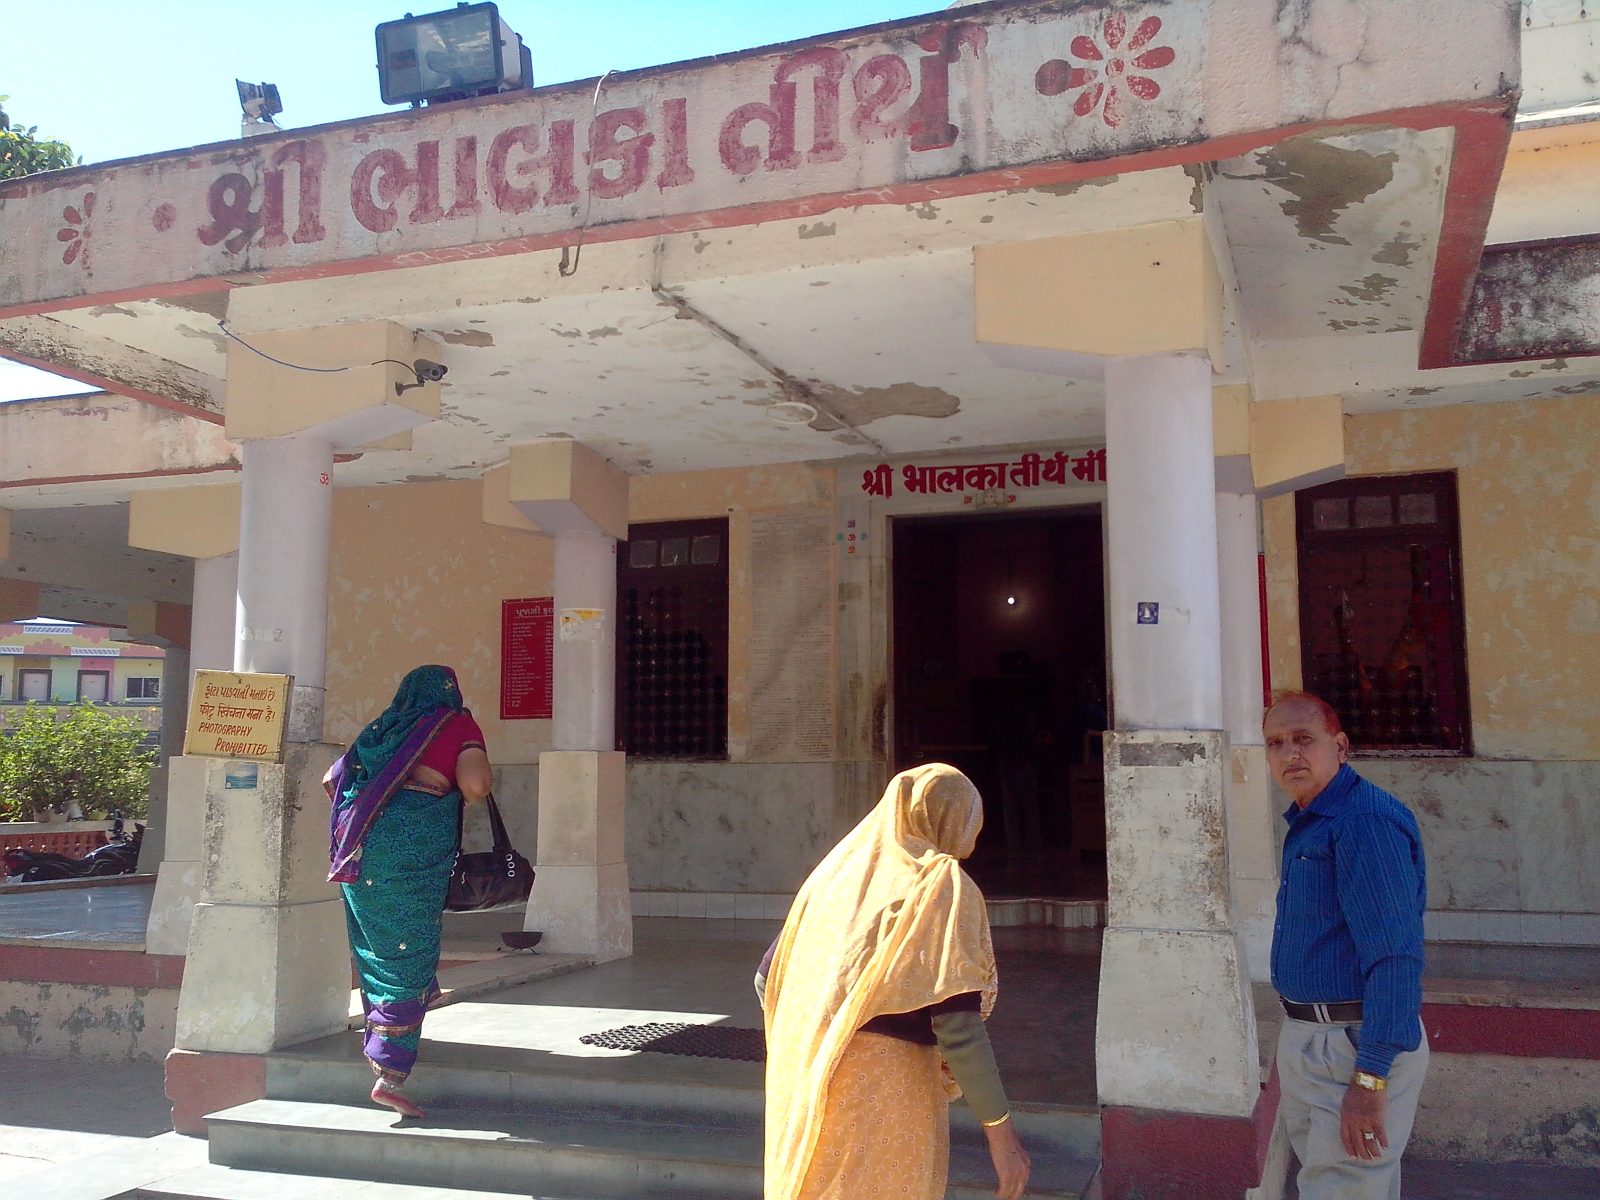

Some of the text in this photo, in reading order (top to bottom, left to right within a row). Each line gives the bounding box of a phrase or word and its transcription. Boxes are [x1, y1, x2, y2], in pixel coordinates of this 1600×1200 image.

[197, 22, 989, 254] શ્રી ભાલકા તીર્થ
[861, 463, 894, 499] श्री
[903, 463, 1008, 494] भालका
[1010, 451, 1069, 486] तीर्थ
[199, 722, 252, 736] PHOTOGRAPHY
[214, 737, 268, 756] PROHIBITTED
